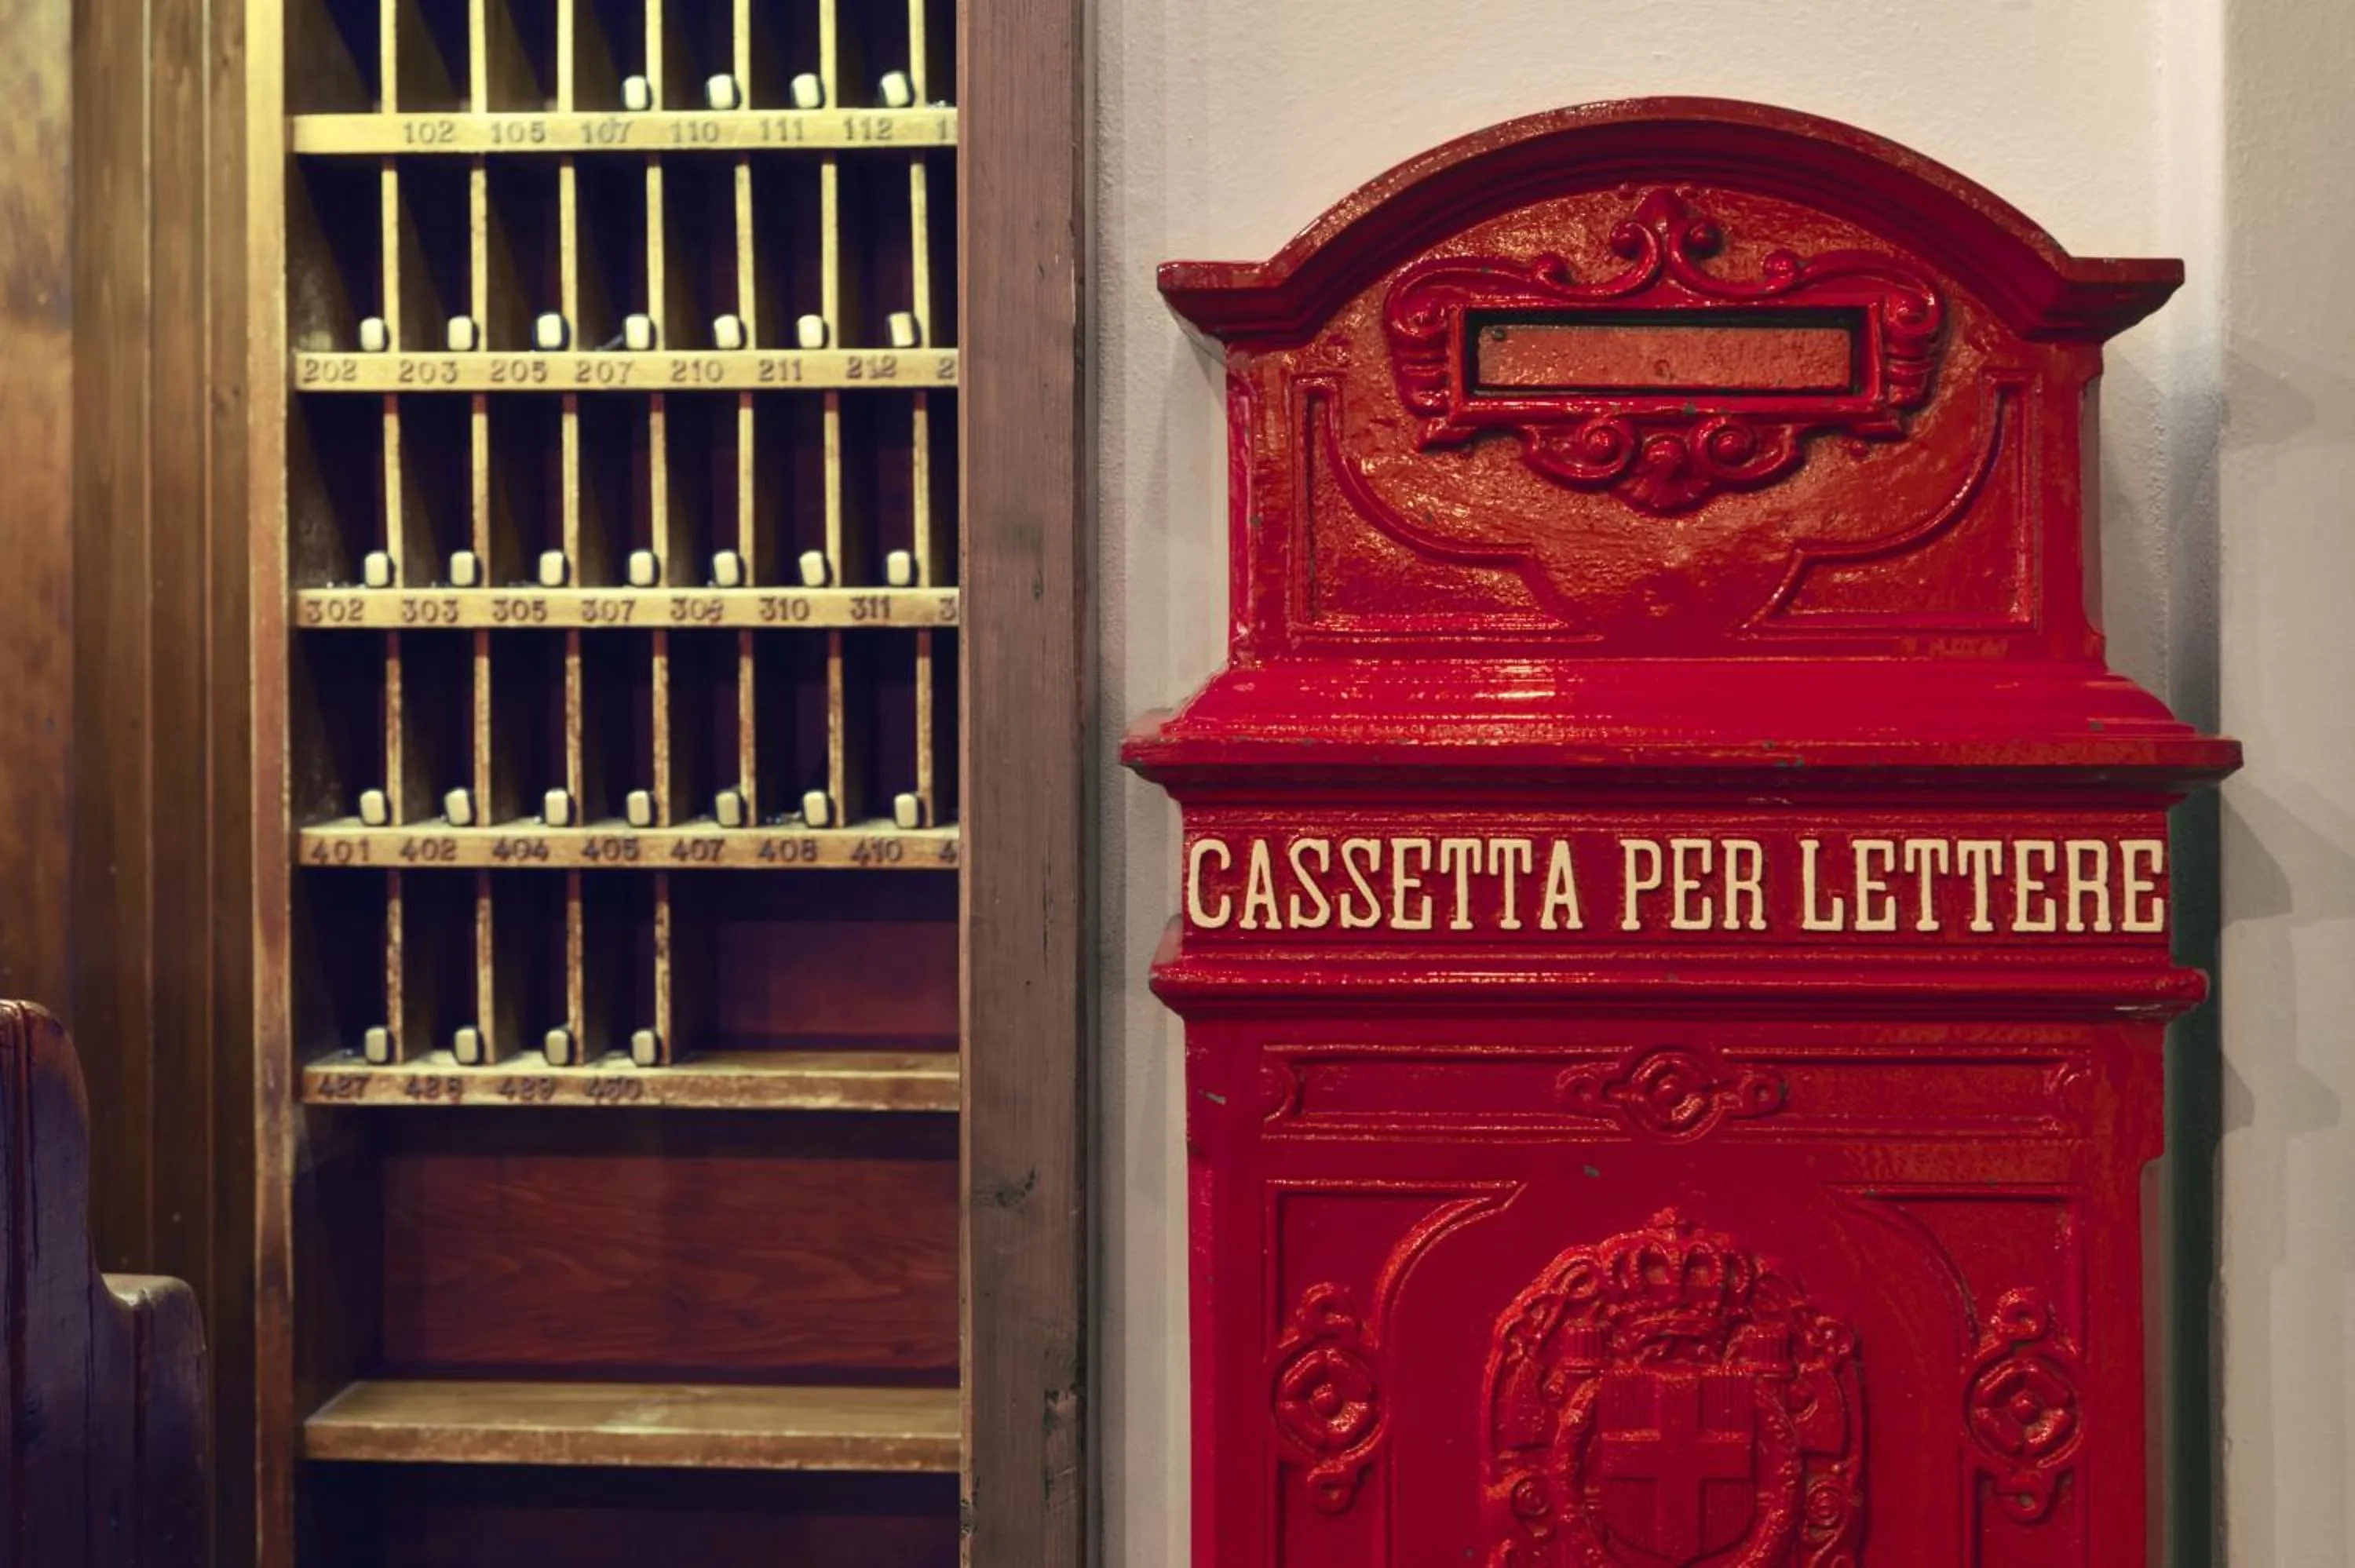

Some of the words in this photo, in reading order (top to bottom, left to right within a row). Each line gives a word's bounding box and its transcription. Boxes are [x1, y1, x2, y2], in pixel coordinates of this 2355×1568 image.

[403, 121, 455, 143] 102
[492, 122, 546, 143] 105
[582, 121, 633, 144] 107
[670, 122, 719, 143] 110
[760, 120, 804, 141] 111
[845, 119, 893, 140] 112
[303, 359, 357, 383] 202
[399, 360, 458, 384] 203
[491, 359, 548, 383] 205
[576, 360, 634, 384] 207
[670, 359, 723, 382] 210
[759, 359, 802, 381] 211
[847, 356, 896, 379] 212
[305, 598, 364, 622] 302
[401, 598, 458, 622] 303
[493, 599, 548, 622] 305
[582, 598, 636, 622] 307
[760, 597, 809, 621] 310
[850, 596, 891, 620] 311
[312, 838, 371, 862] 401
[400, 838, 456, 861] 402
[493, 838, 549, 861] 404
[582, 837, 641, 861] 405
[670, 838, 725, 862] 407
[759, 839, 817, 862] 408
[851, 838, 903, 863] 410
[1188, 838, 1584, 931] CASSETTA
[1620, 838, 1766, 931] PER
[1800, 838, 2164, 932] LETTERE
